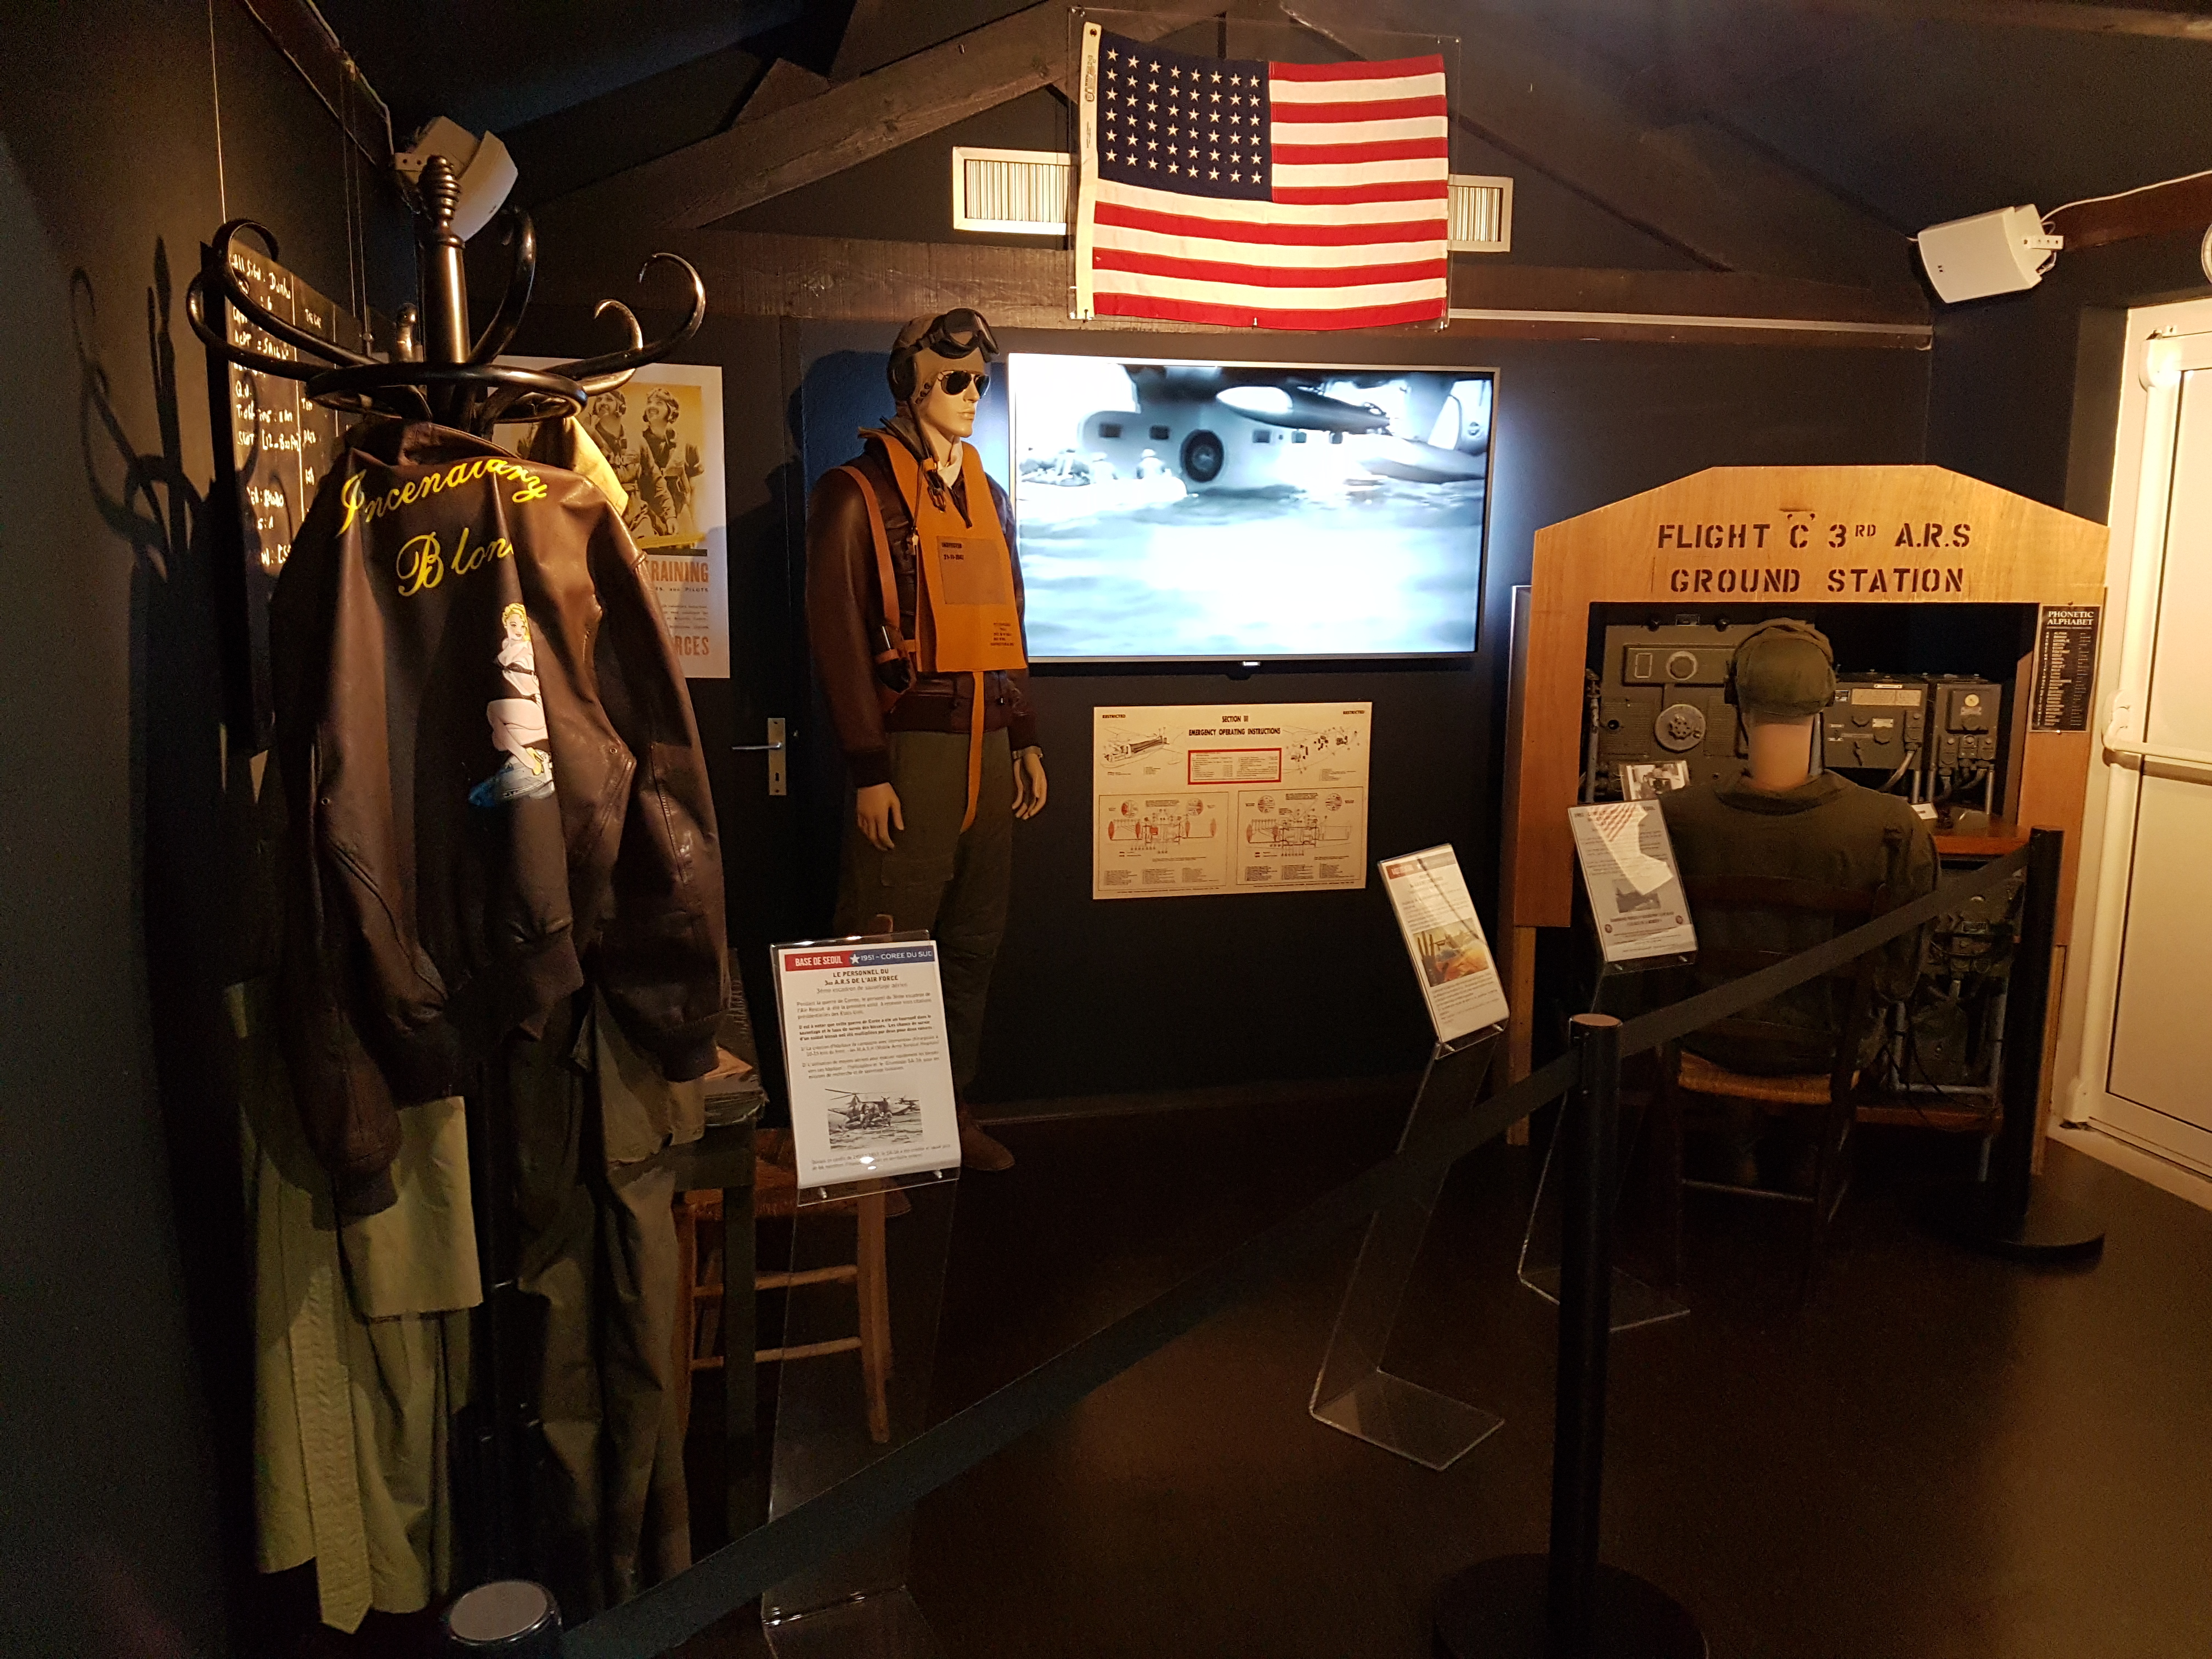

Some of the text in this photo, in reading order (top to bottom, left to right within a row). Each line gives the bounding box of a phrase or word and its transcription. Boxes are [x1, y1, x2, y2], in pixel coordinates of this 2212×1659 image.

[1658, 524, 1770, 548] FLIGHT
[1790, 524, 1809, 548] C
[1894, 523, 1971, 548] A.R.S
[396, 527, 514, 596] Blon
[1671, 568, 1963, 592] GROUND STATION
[674, 635, 709, 656] RCES
[795, 956, 843, 966] BASE DE SEOUL
